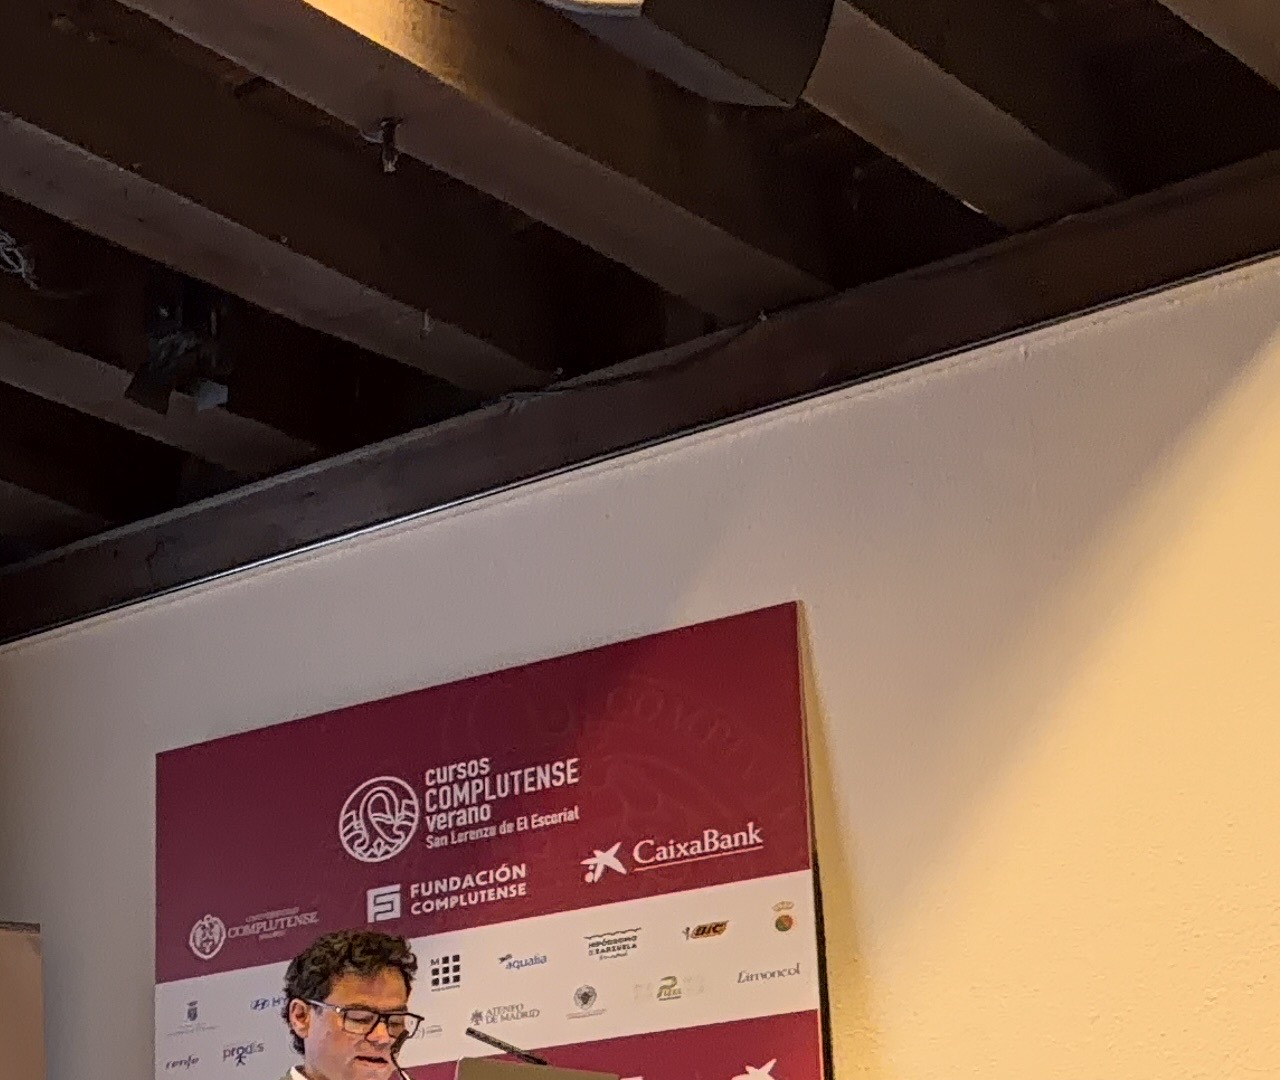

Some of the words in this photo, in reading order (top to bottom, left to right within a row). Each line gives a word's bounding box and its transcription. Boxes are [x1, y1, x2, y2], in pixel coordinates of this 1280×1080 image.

[425, 758, 490, 787] cursos
[425, 758, 580, 813] COMPLUTENSE
[425, 803, 492, 833] verano
[426, 832, 448, 850] San
[451, 826, 495, 845] Lorenzo
[500, 821, 514, 835] de
[517, 817, 529, 831] El
[532, 805, 580, 827] Escorial
[633, 822, 763, 860] CaixaBank
[411, 863, 527, 899] FUNDACIÓN
[411, 882, 527, 916] COMPLUTENSE
[228, 912, 319, 938] COMPLUTENSE
[506, 954, 547, 970] aqualia
[500, 1009, 540, 1023] MADRID
